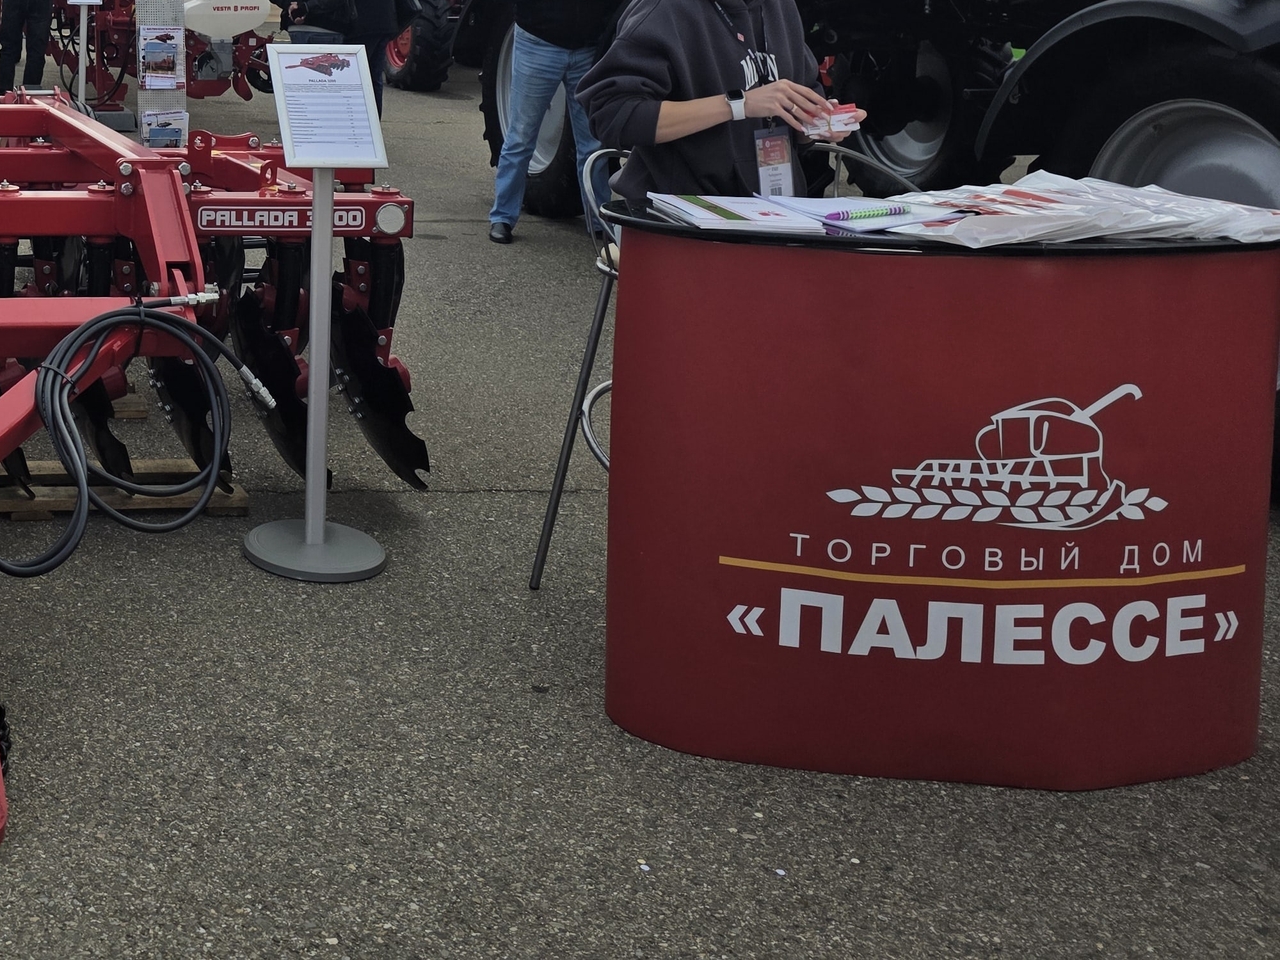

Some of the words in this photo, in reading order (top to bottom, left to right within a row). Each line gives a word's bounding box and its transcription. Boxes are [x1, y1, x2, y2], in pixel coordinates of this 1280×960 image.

[201, 210, 298, 226] PALLADA
[789, 532, 1079, 571] ТОРГОВЫЙ
[1120, 538, 1202, 574] ДОМ
[726, 587, 1239, 666] «ПАЛЕССЕ»
